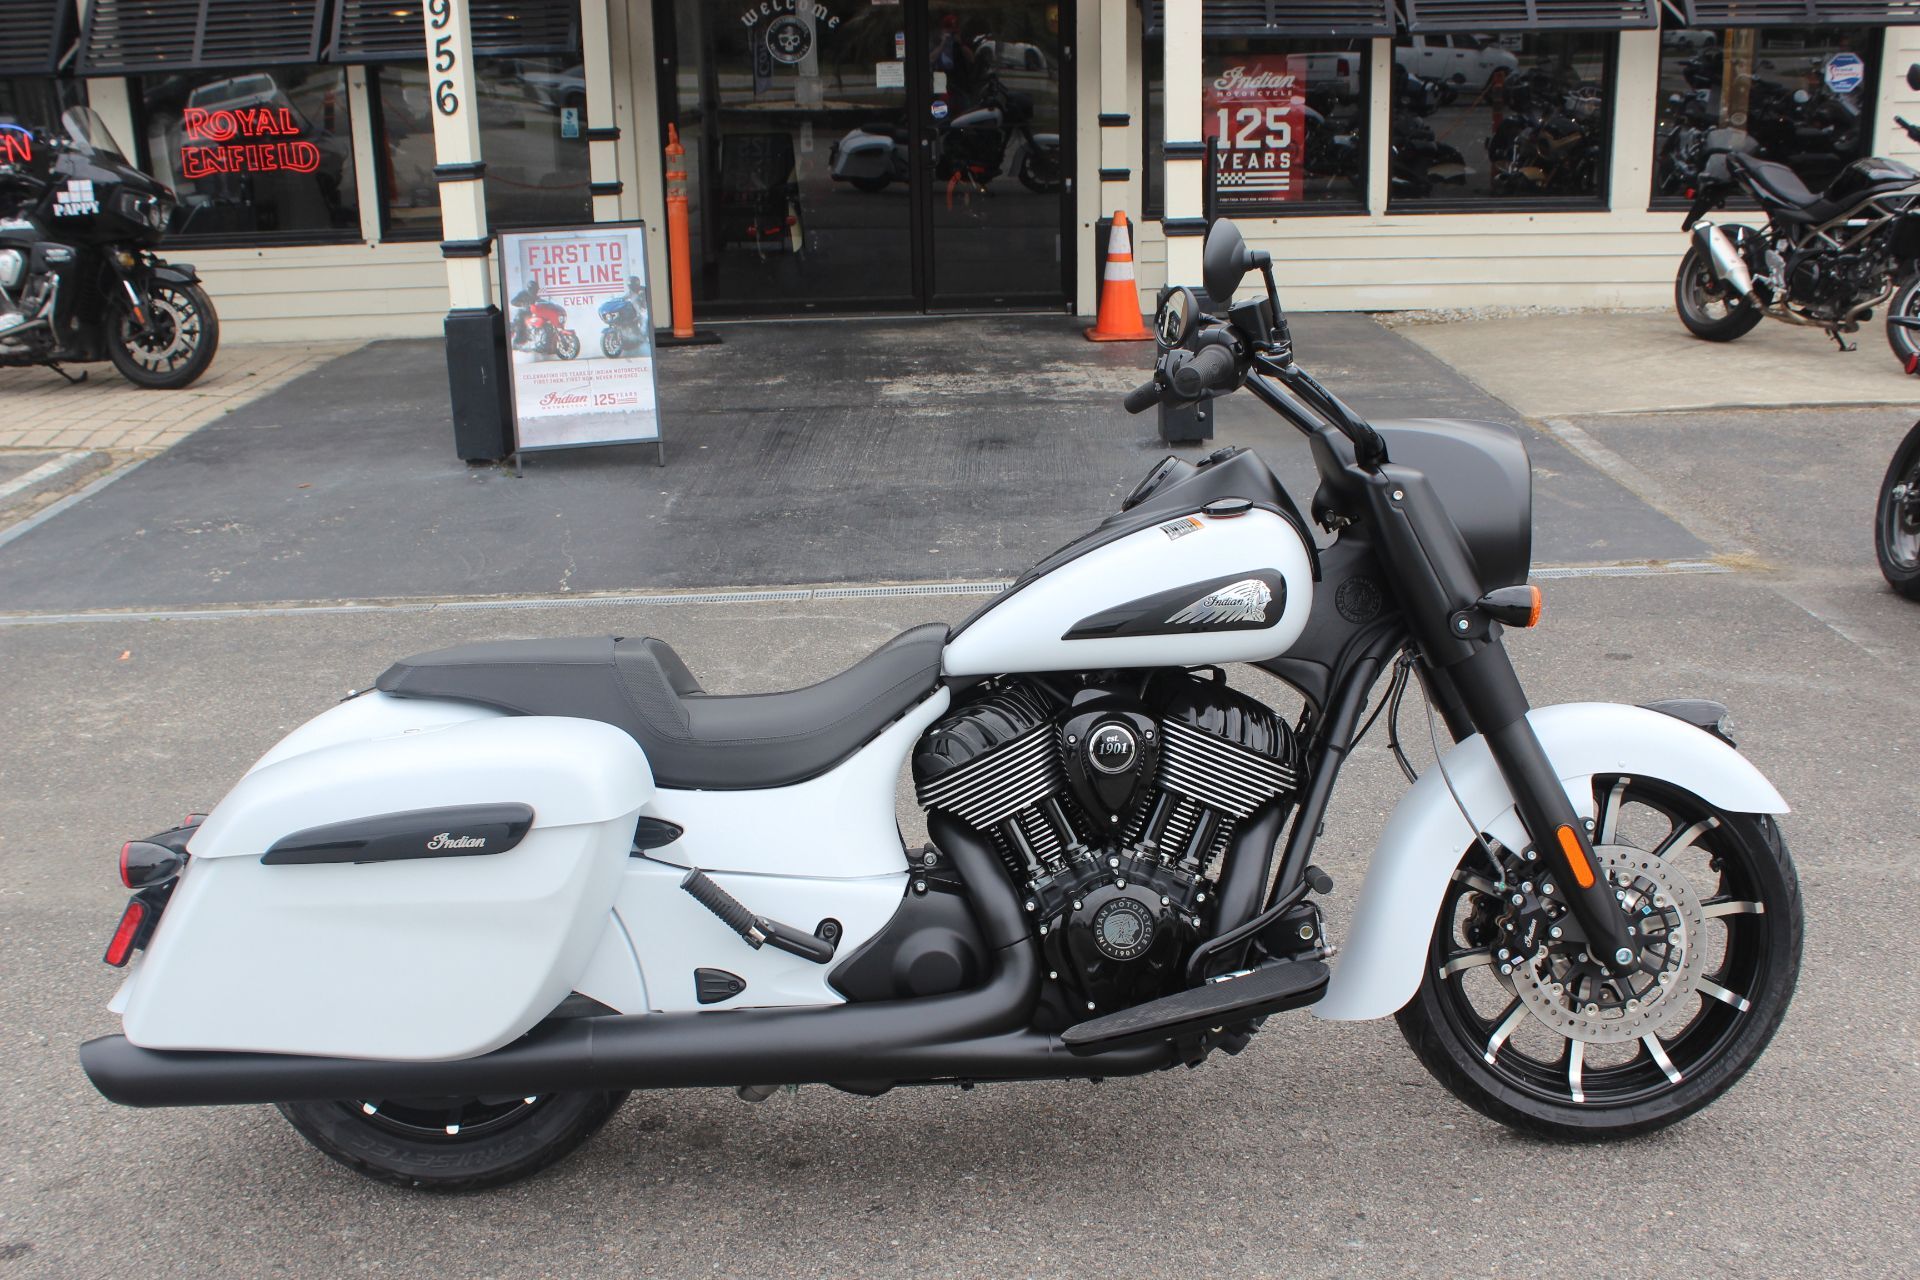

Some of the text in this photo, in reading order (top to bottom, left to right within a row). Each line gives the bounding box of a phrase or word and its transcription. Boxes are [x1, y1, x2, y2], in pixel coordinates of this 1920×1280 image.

[1213, 66, 1296, 90] Indian
[183, 107, 299, 141] ROYAL
[1216, 107, 1291, 149] 125
[181, 142, 320, 178] ENFIELD
[1216, 152, 1291, 169] YEARS
[52, 201, 100, 217] PAPPY
[596, 242, 622, 262] TO
[530, 263, 624, 286] THE LINE
[563, 296, 594, 306] EVENT
[539, 391, 588, 406] Indian
[594, 393, 617, 406] 125
[1203, 595, 1244, 608] Indian
[1098, 742, 1128, 755] 1901
[427, 832, 486, 850] Indian
[1096, 901, 1152, 947] INDIAN MOTORCYCLE
[1114, 948, 1136, 957] 1901
